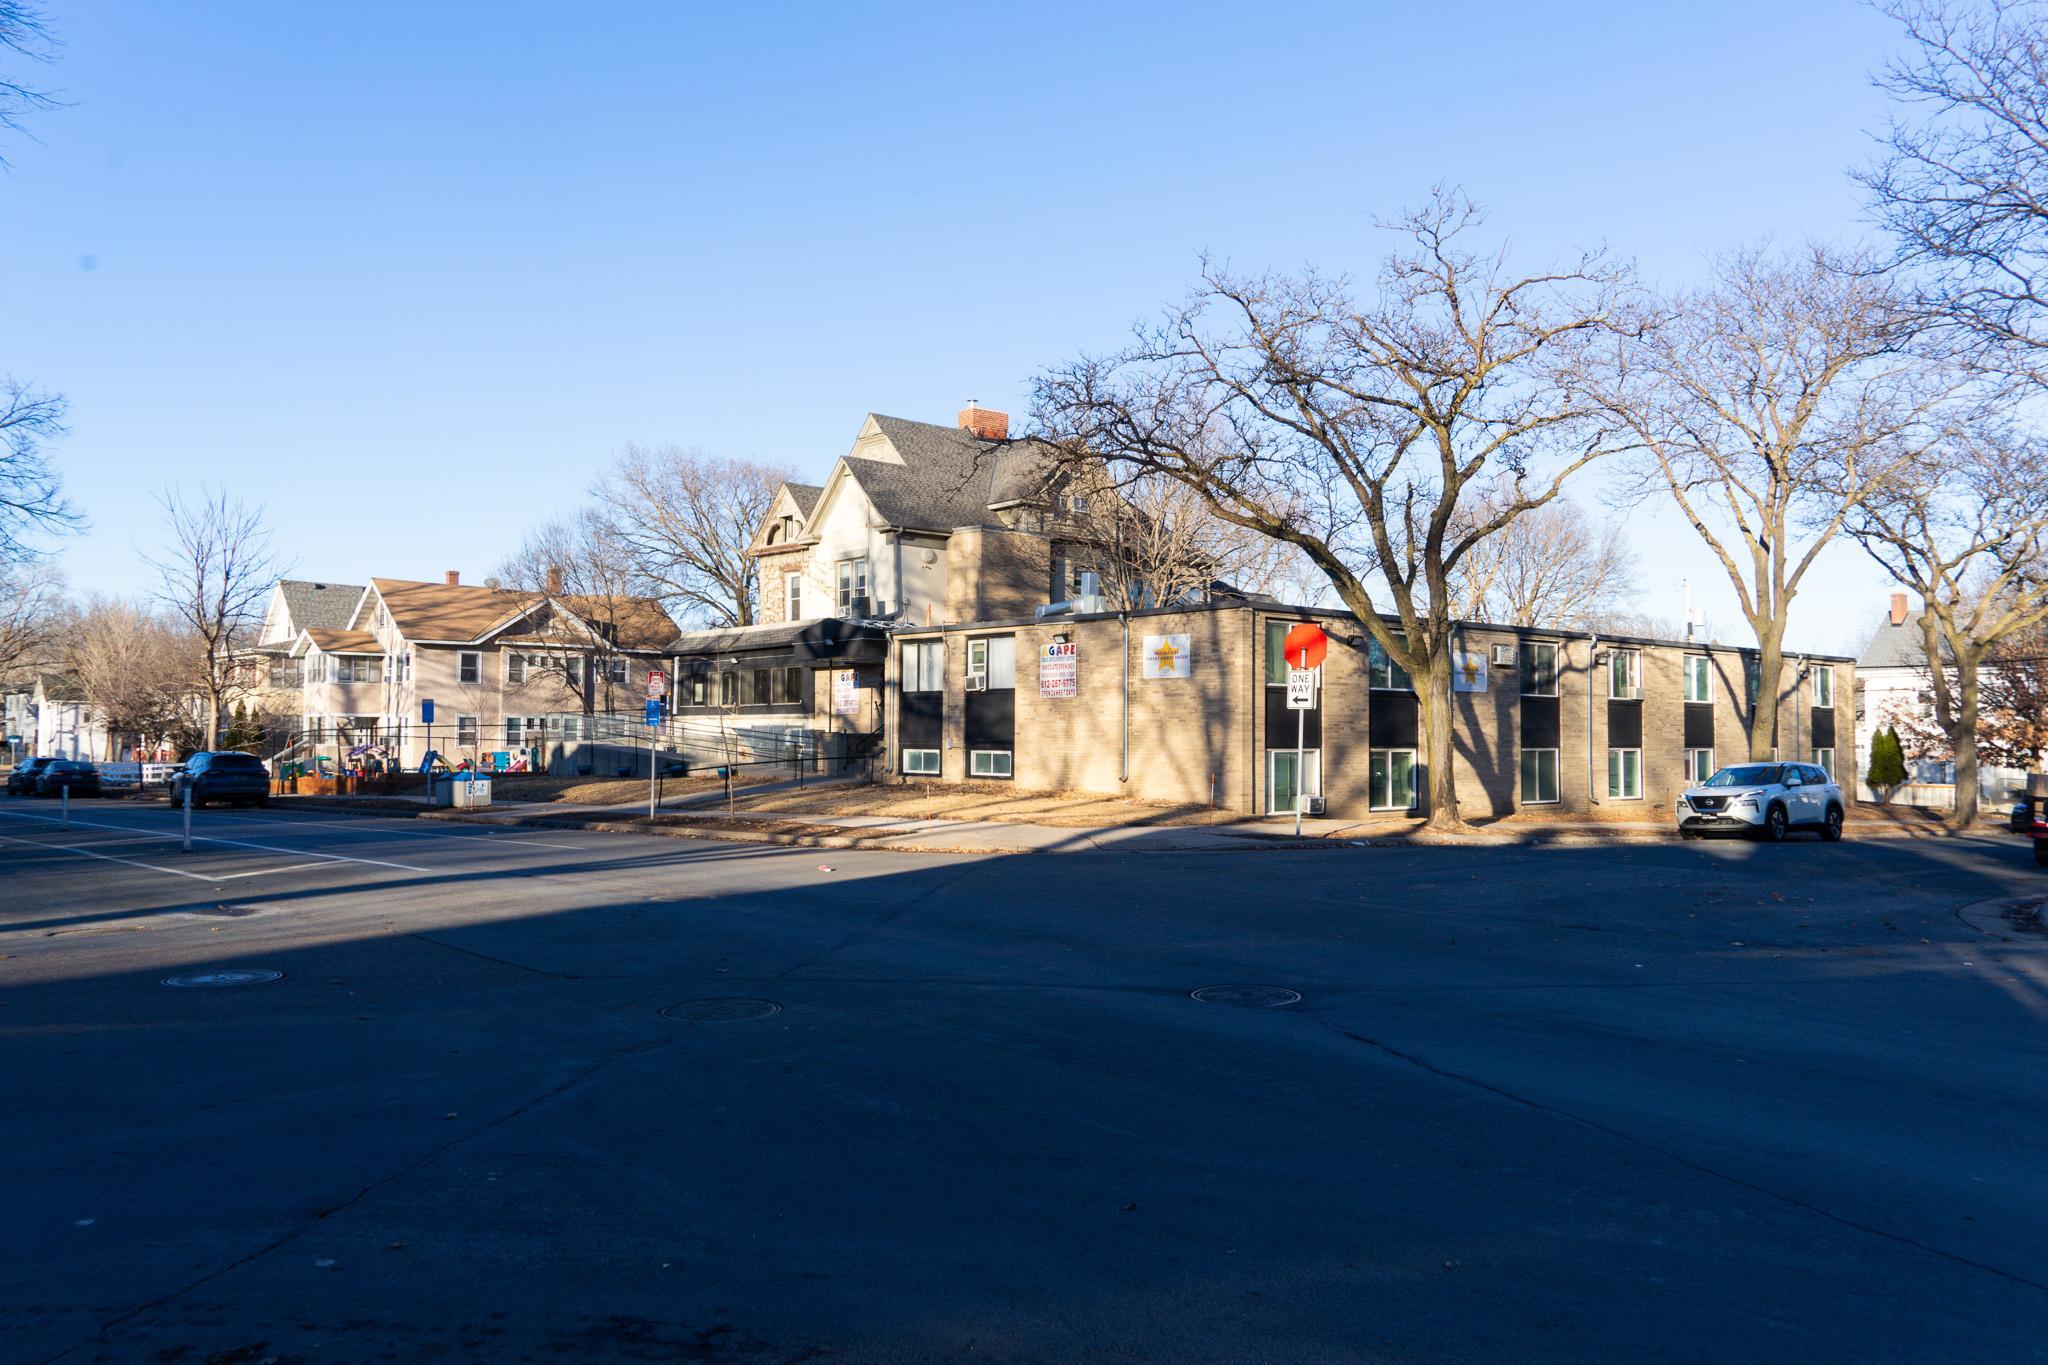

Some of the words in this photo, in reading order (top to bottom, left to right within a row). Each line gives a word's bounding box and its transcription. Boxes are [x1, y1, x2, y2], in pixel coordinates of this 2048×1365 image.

[1041, 644, 1075, 656] AGAPE
[1041, 678, 1075, 688] 612-287-9775
[1292, 674, 1309, 683] ONE
[1291, 685, 1310, 693] WAY
